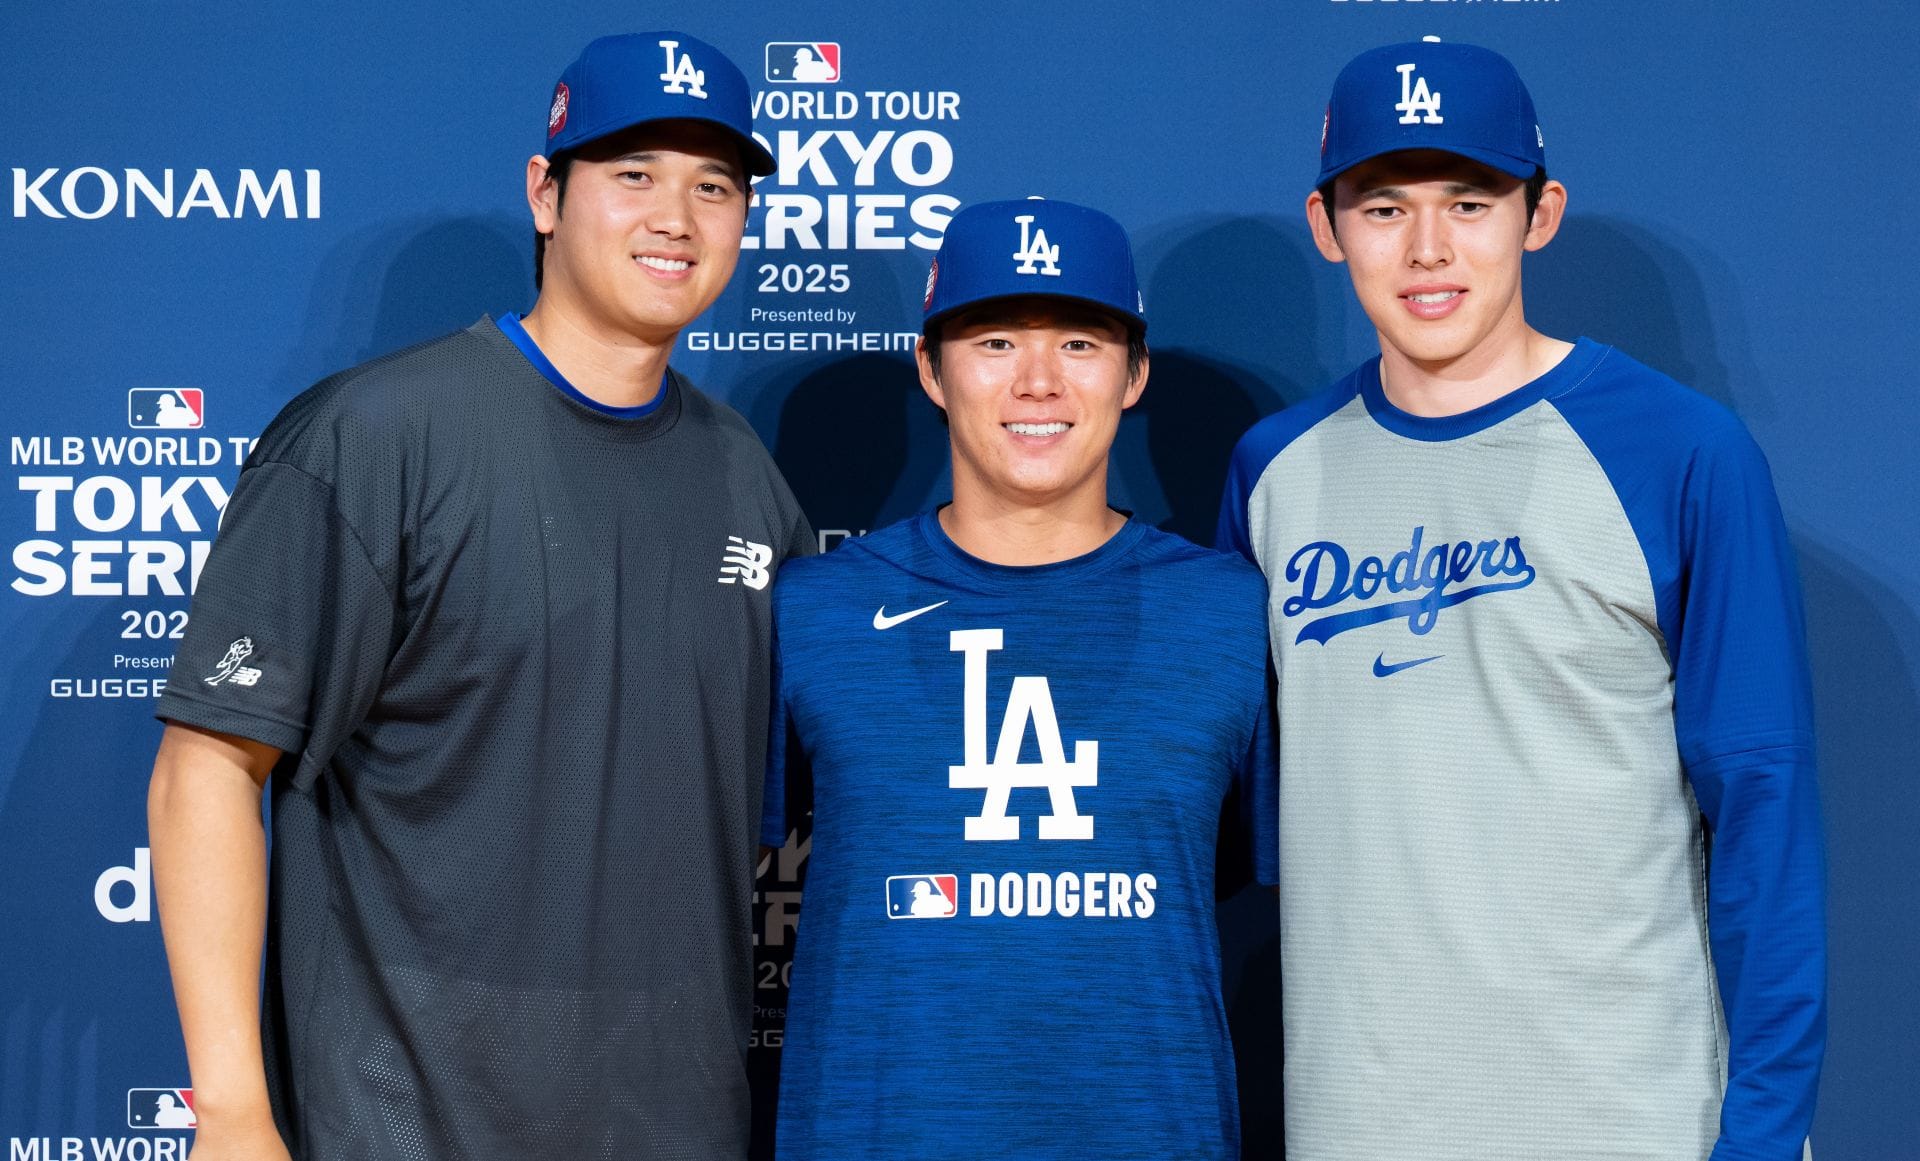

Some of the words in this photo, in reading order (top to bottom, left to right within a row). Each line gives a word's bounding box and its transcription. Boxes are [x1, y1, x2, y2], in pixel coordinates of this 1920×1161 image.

[659, 40, 708, 99] LA
[865, 91, 961, 121] TOUR
[1395, 63, 1444, 125] LA
[750, 129, 954, 187] KYO
[11, 166, 321, 220] KONAMI
[741, 193, 962, 250] RIES
[1012, 215, 1062, 276] LA
[758, 263, 851, 293] 2025
[751, 308, 833, 322] Presented
[837, 308, 857, 325] by
[687, 332, 919, 351] GUGGENHEIM
[11, 436, 85, 466] MLB
[91, 436, 223, 466] WORLD
[10, 539, 212, 597] SERI
[1283, 526, 1537, 636] Dodgers
[121, 610, 189, 639] 202
[114, 654, 175, 669] Present
[50, 678, 168, 698] GUGGE
[948, 628, 1099, 841] LA
[970, 871, 1157, 919] DODGERS
[10, 1137, 84, 1161] MLB
